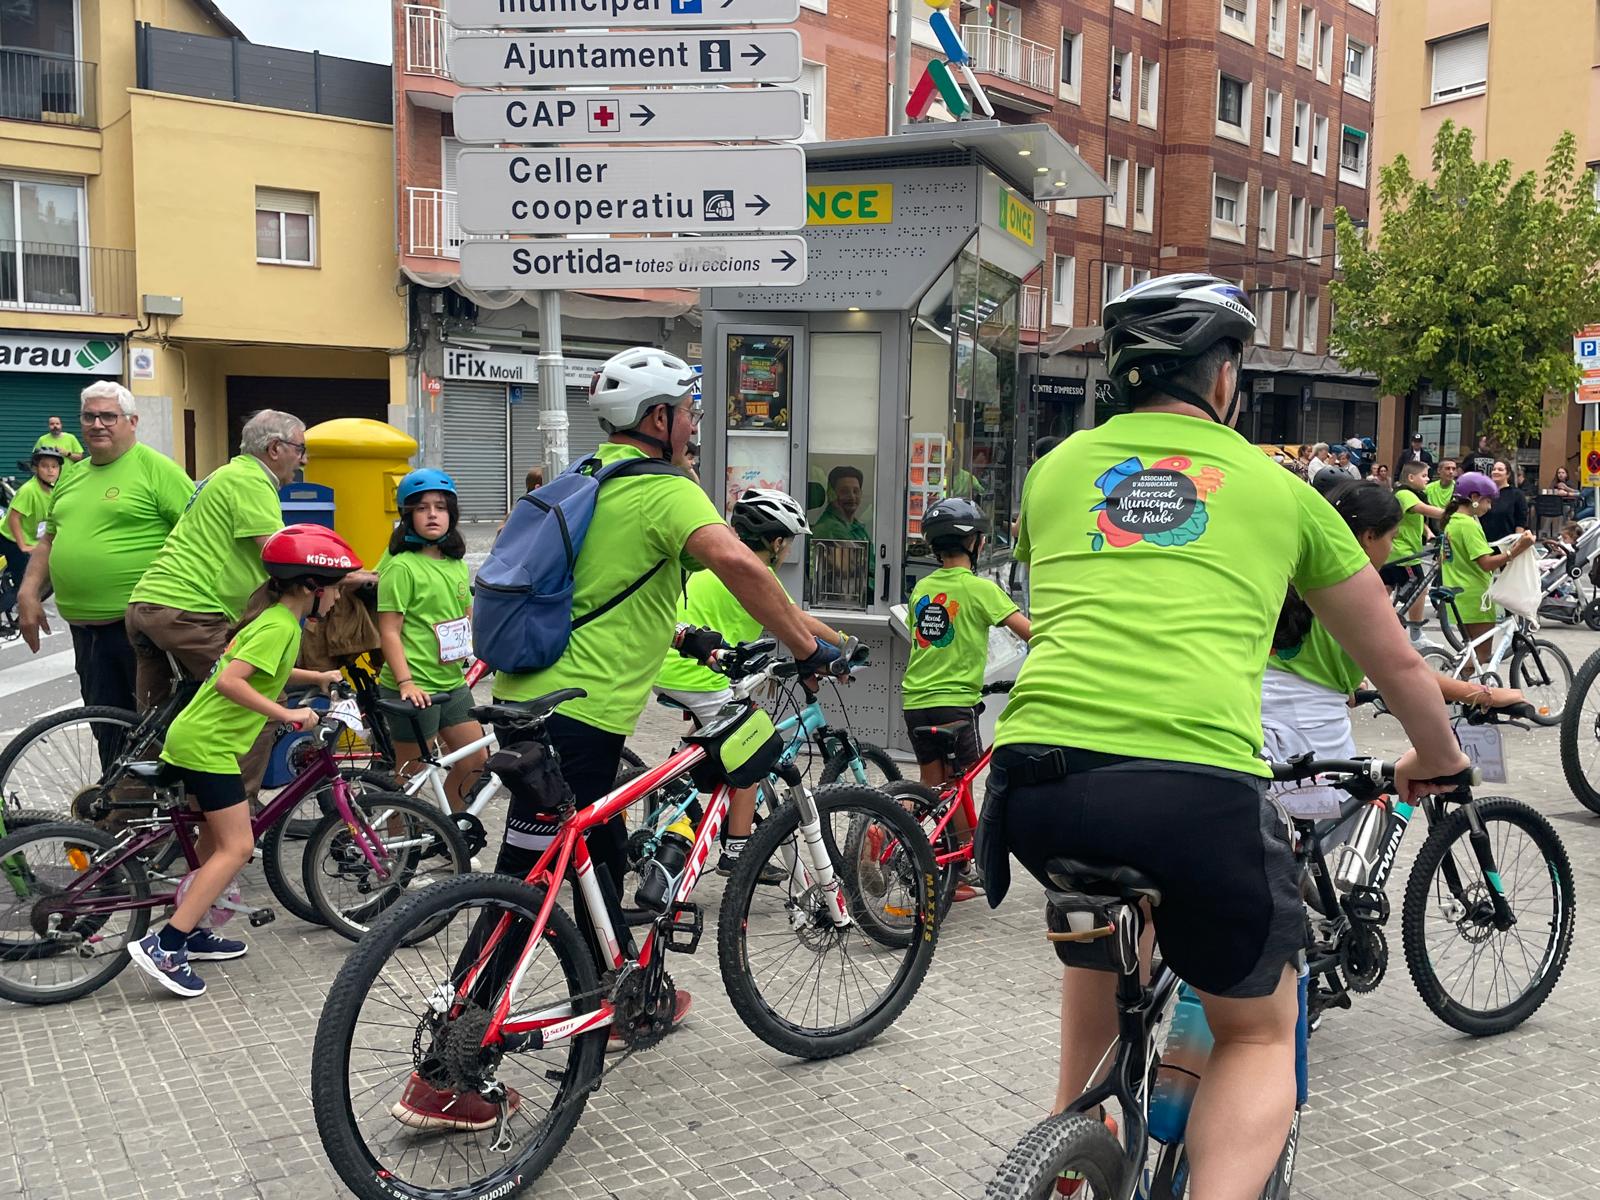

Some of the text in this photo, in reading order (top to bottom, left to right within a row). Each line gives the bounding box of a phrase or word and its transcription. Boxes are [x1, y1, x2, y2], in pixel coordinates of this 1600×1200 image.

[504, 42, 689, 75] Ajuntament
[506, 101, 576, 128] CAP
[508, 157, 608, 184] Celler
[511, 193, 694, 225] cooperatiu
[1010, 202, 1032, 240] ONCE
[449, 352, 523, 380] iFix Movil
[1032, 384, 1053, 394] CNTRE
[1117, 497, 1185, 513] Municipal
[1128, 489, 1177, 498] Mercat
[1121, 510, 1175, 524] de Rubí
[924, 873, 936, 943] MAXXIS
[550, 1023, 576, 1036] SCOTT
[479, 1180, 516, 1200] vittoria
